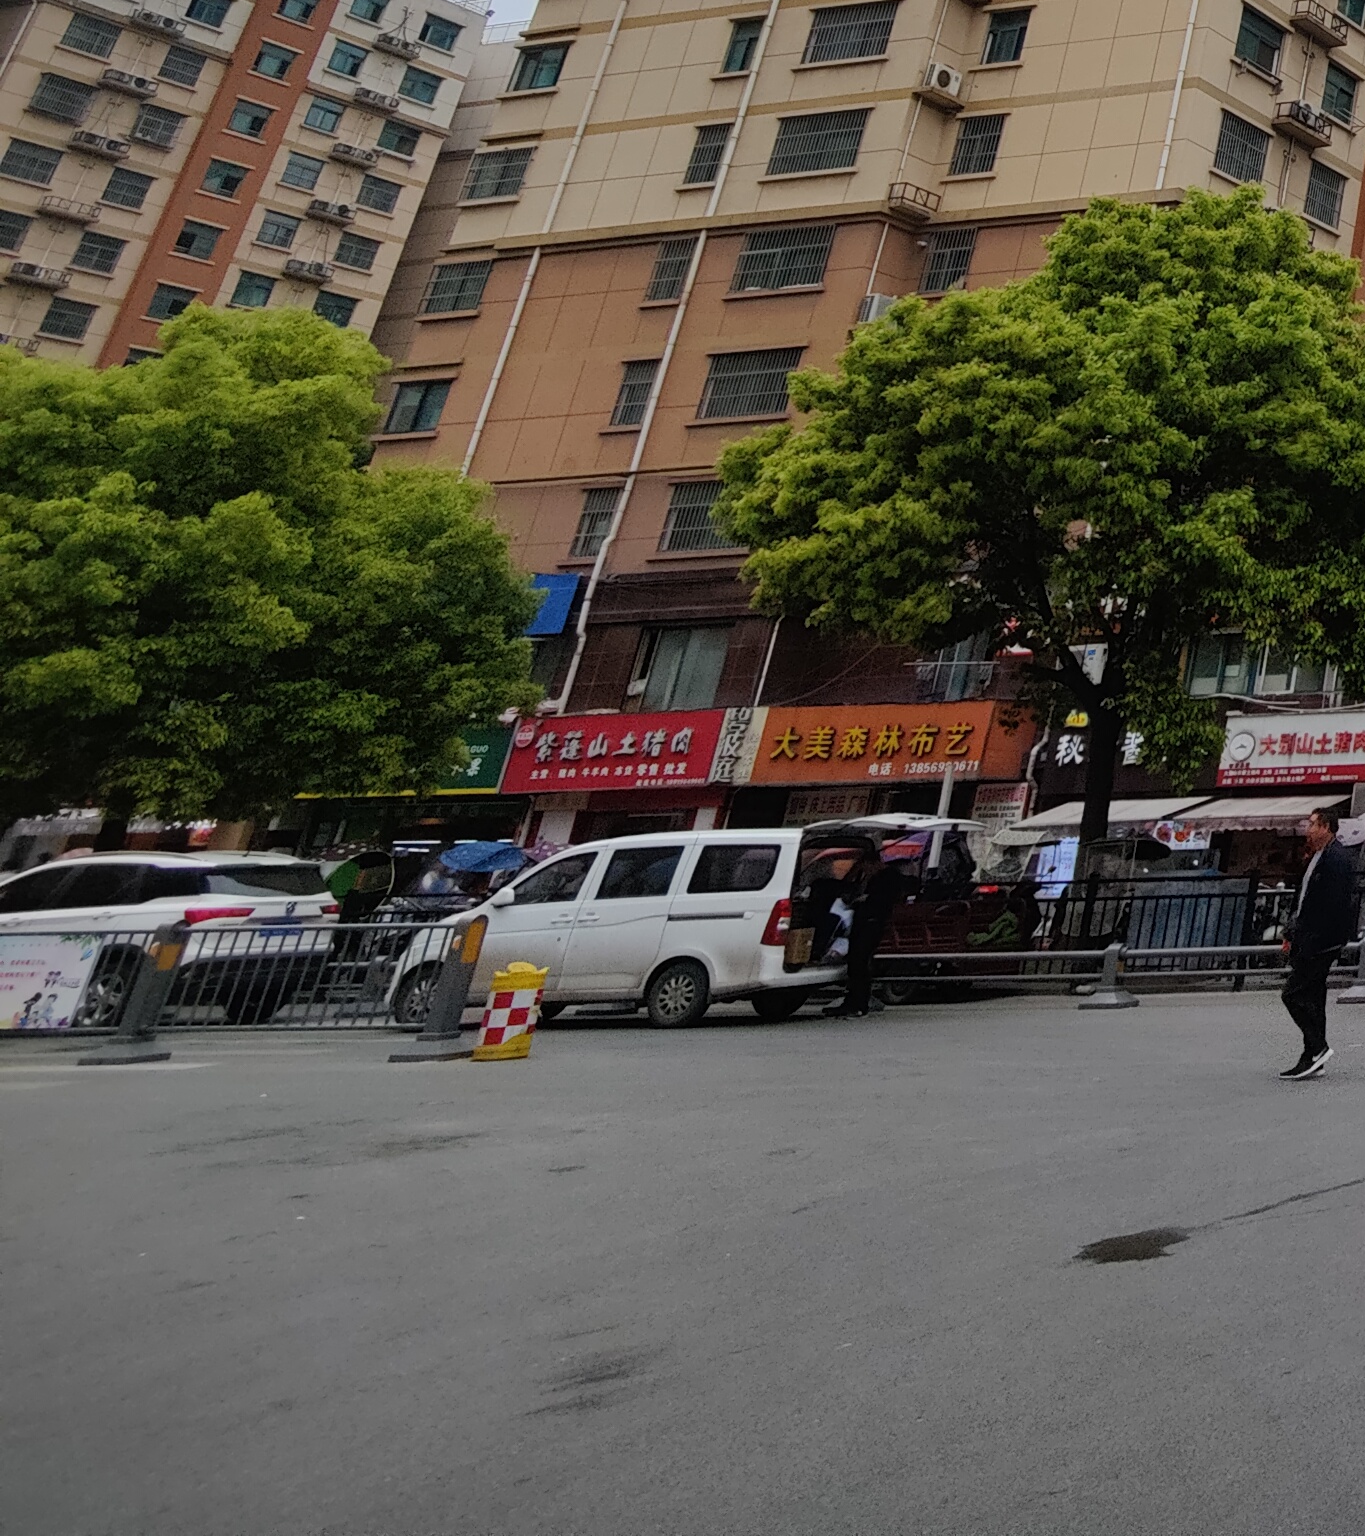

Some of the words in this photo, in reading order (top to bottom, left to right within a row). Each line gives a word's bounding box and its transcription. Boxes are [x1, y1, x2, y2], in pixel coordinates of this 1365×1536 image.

[769, 723, 974, 761] 大美森林布艺
